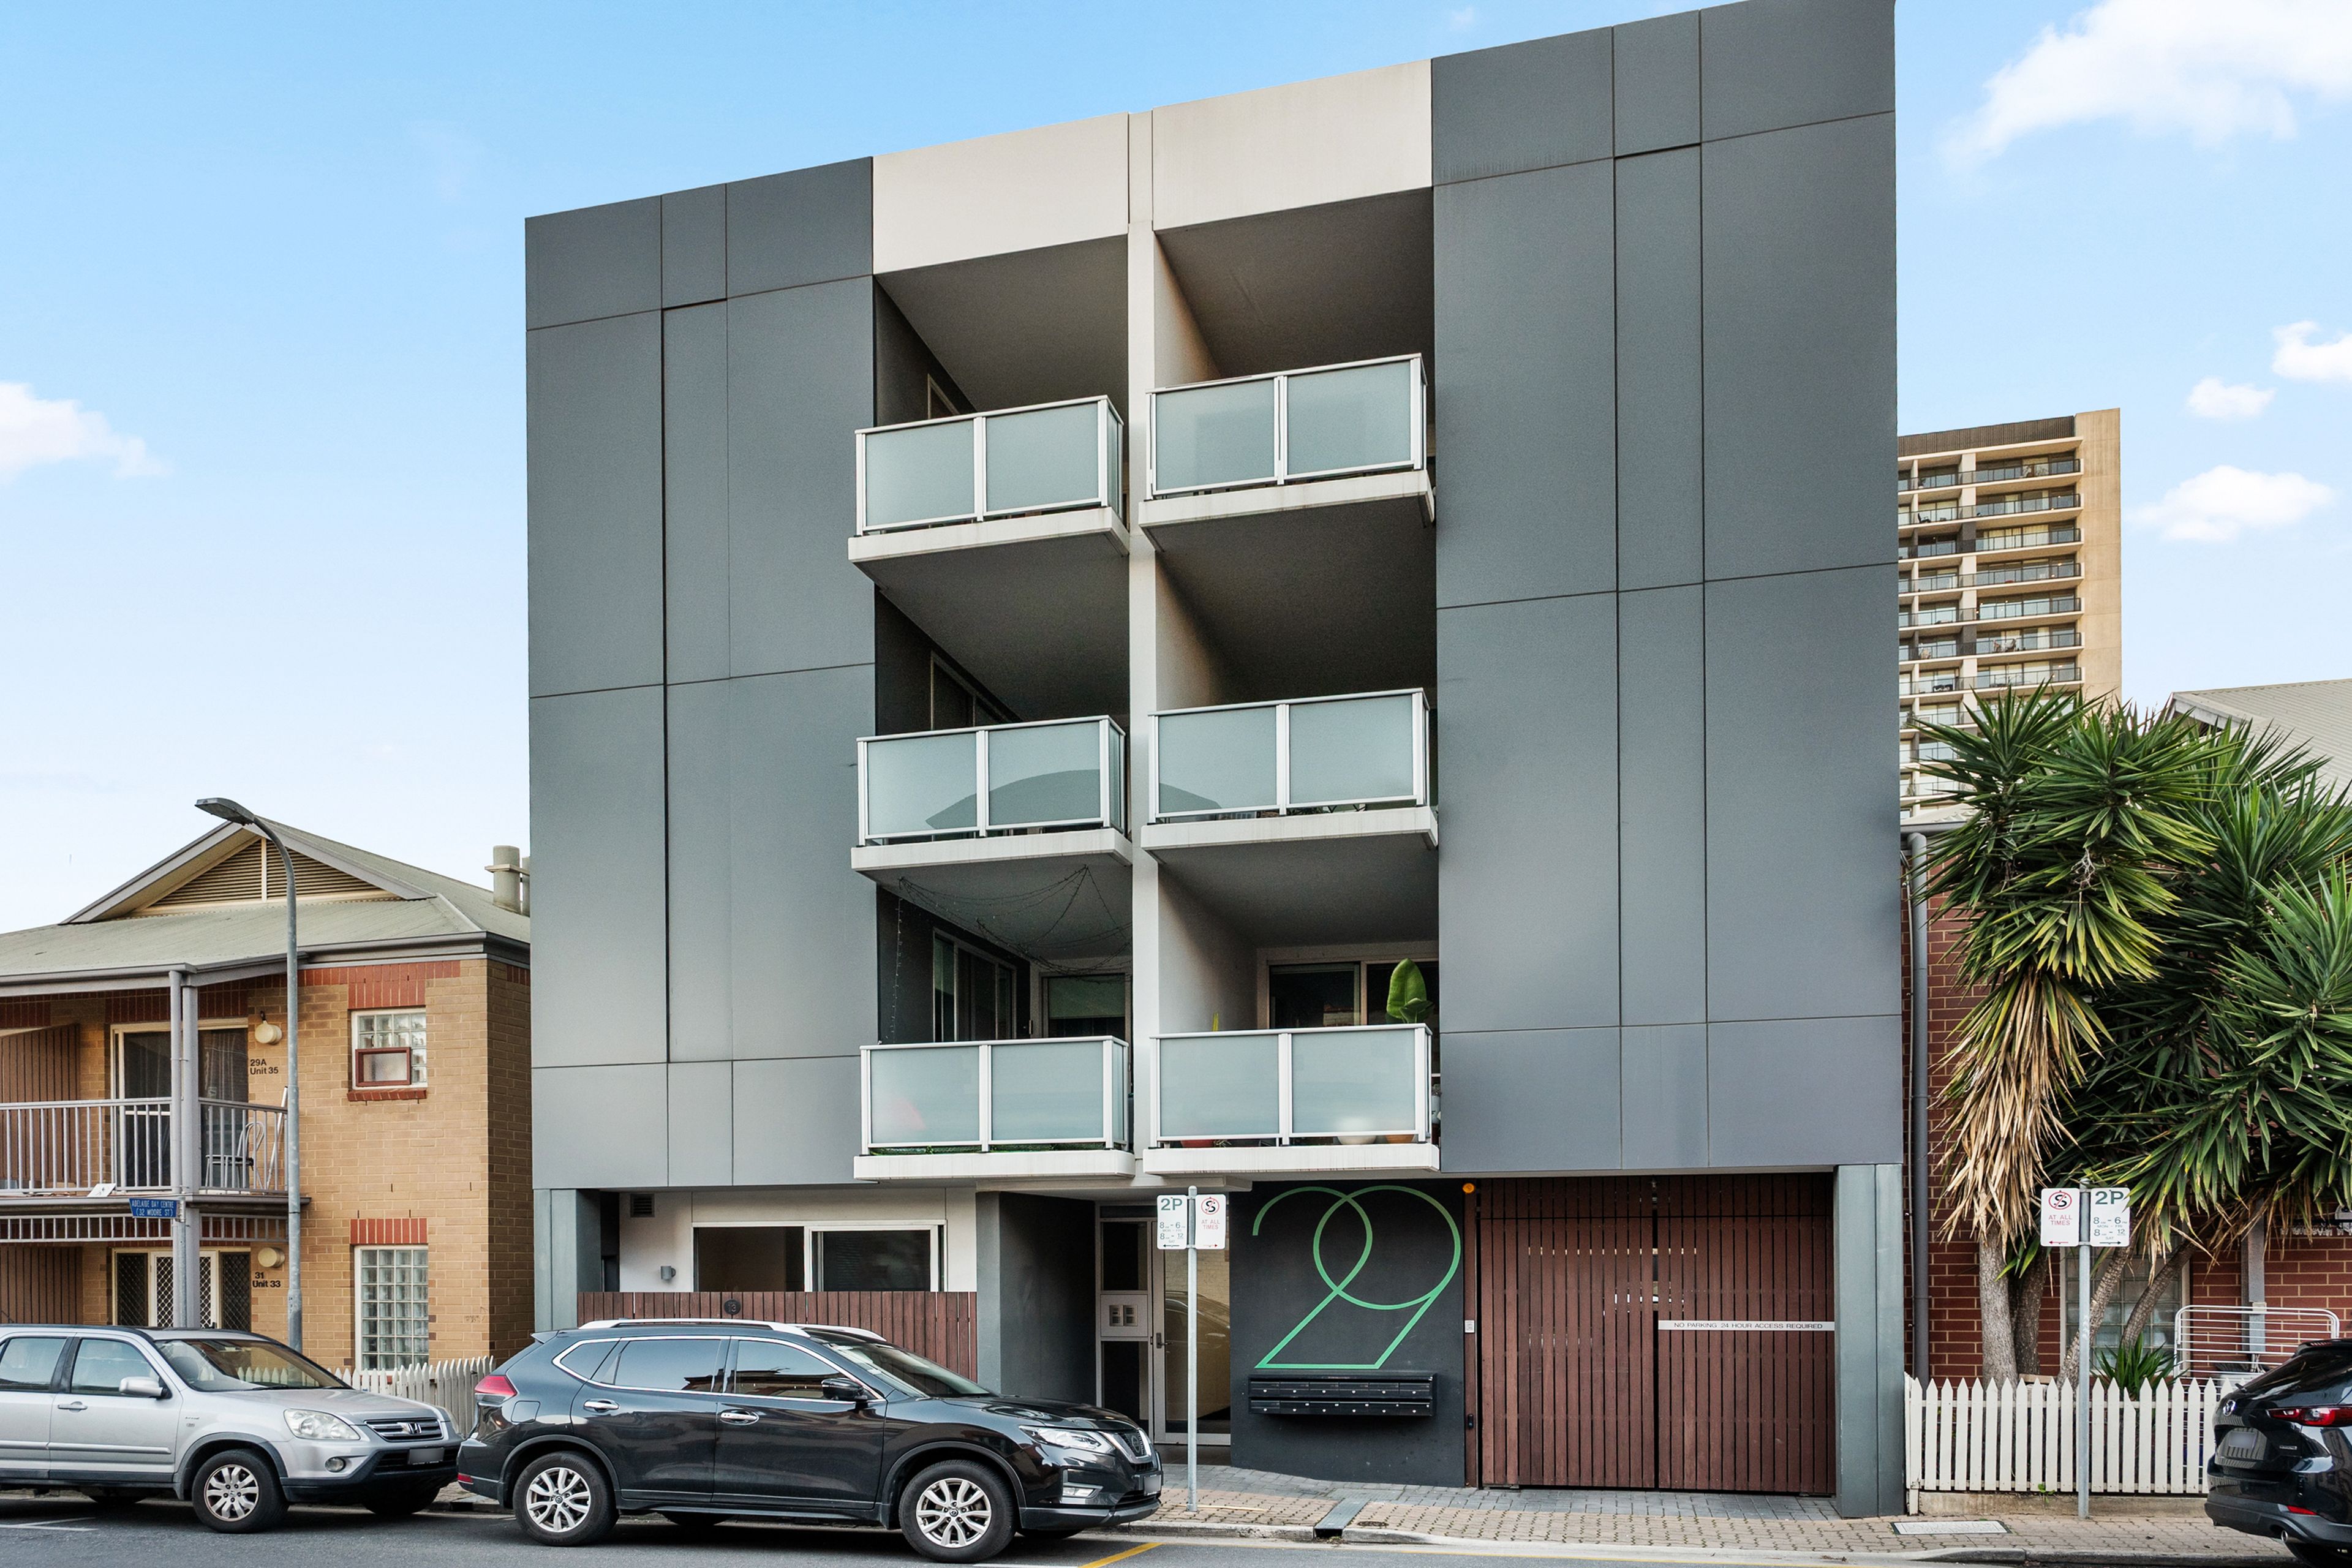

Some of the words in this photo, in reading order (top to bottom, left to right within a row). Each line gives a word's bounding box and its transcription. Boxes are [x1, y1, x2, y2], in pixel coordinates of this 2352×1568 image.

[1161, 1198, 1183, 1210] 2P
[2095, 1191, 2124, 1204] 2P
[1253, 1185, 1461, 1369] 29
